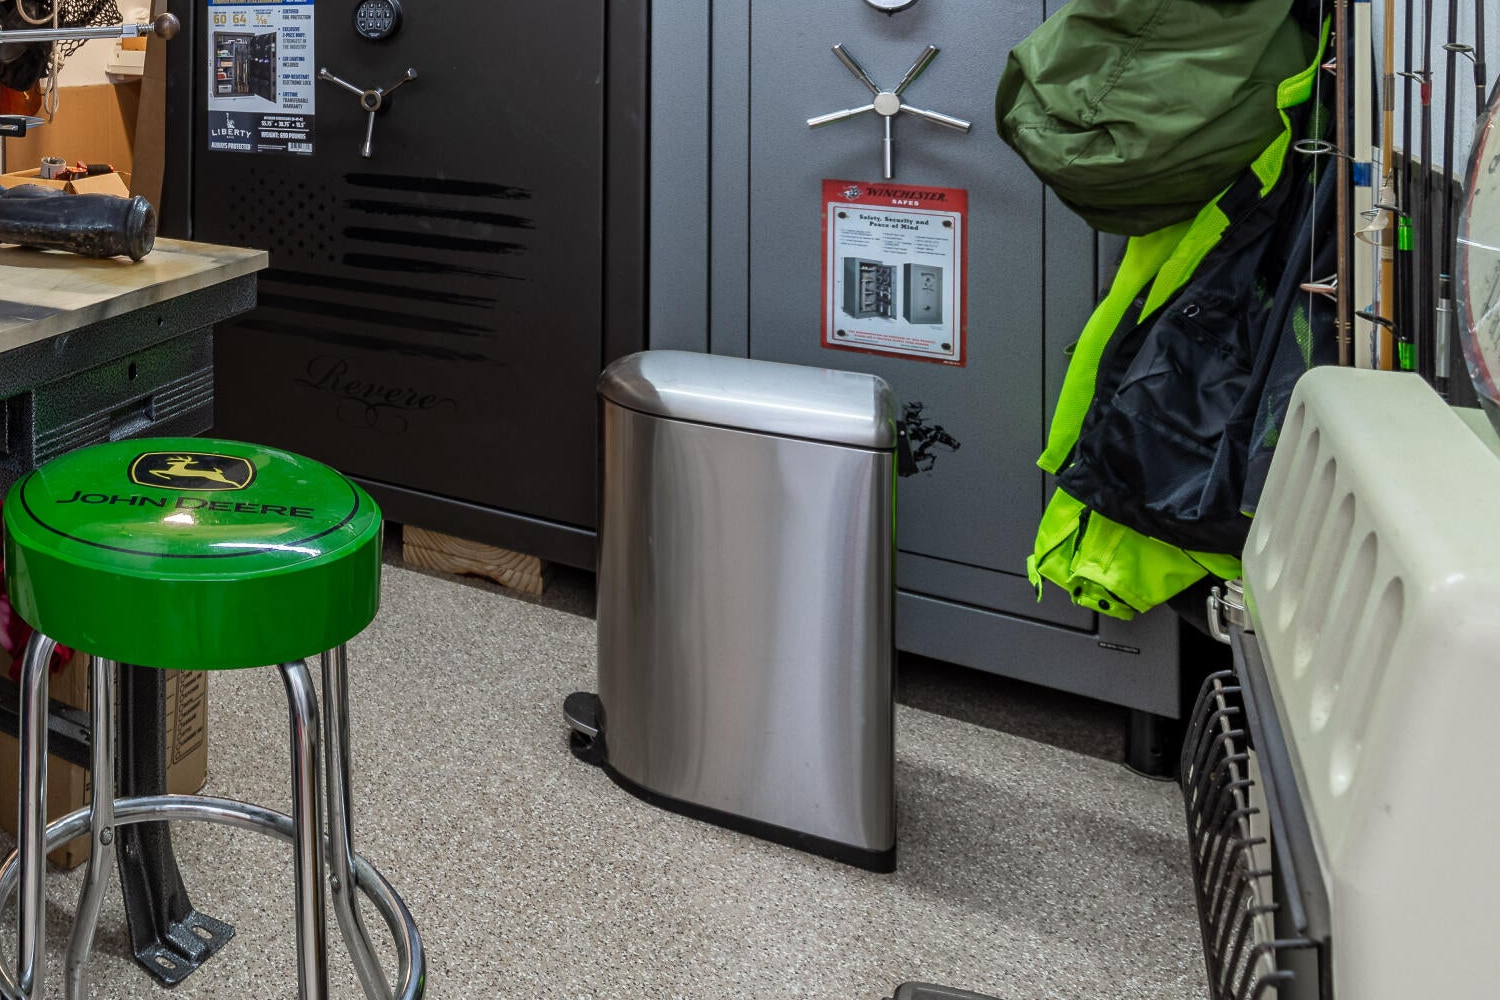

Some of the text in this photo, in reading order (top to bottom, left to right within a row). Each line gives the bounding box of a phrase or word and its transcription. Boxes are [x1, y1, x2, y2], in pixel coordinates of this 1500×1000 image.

[213, 14, 226, 24] 60
[232, 14, 246, 24] 64
[212, 128, 251, 138] LIBERTY
[866, 187, 946, 201] WINCHESTER
[885, 216, 913, 225] Security
[55, 490, 314, 519] JOHN DEERE
